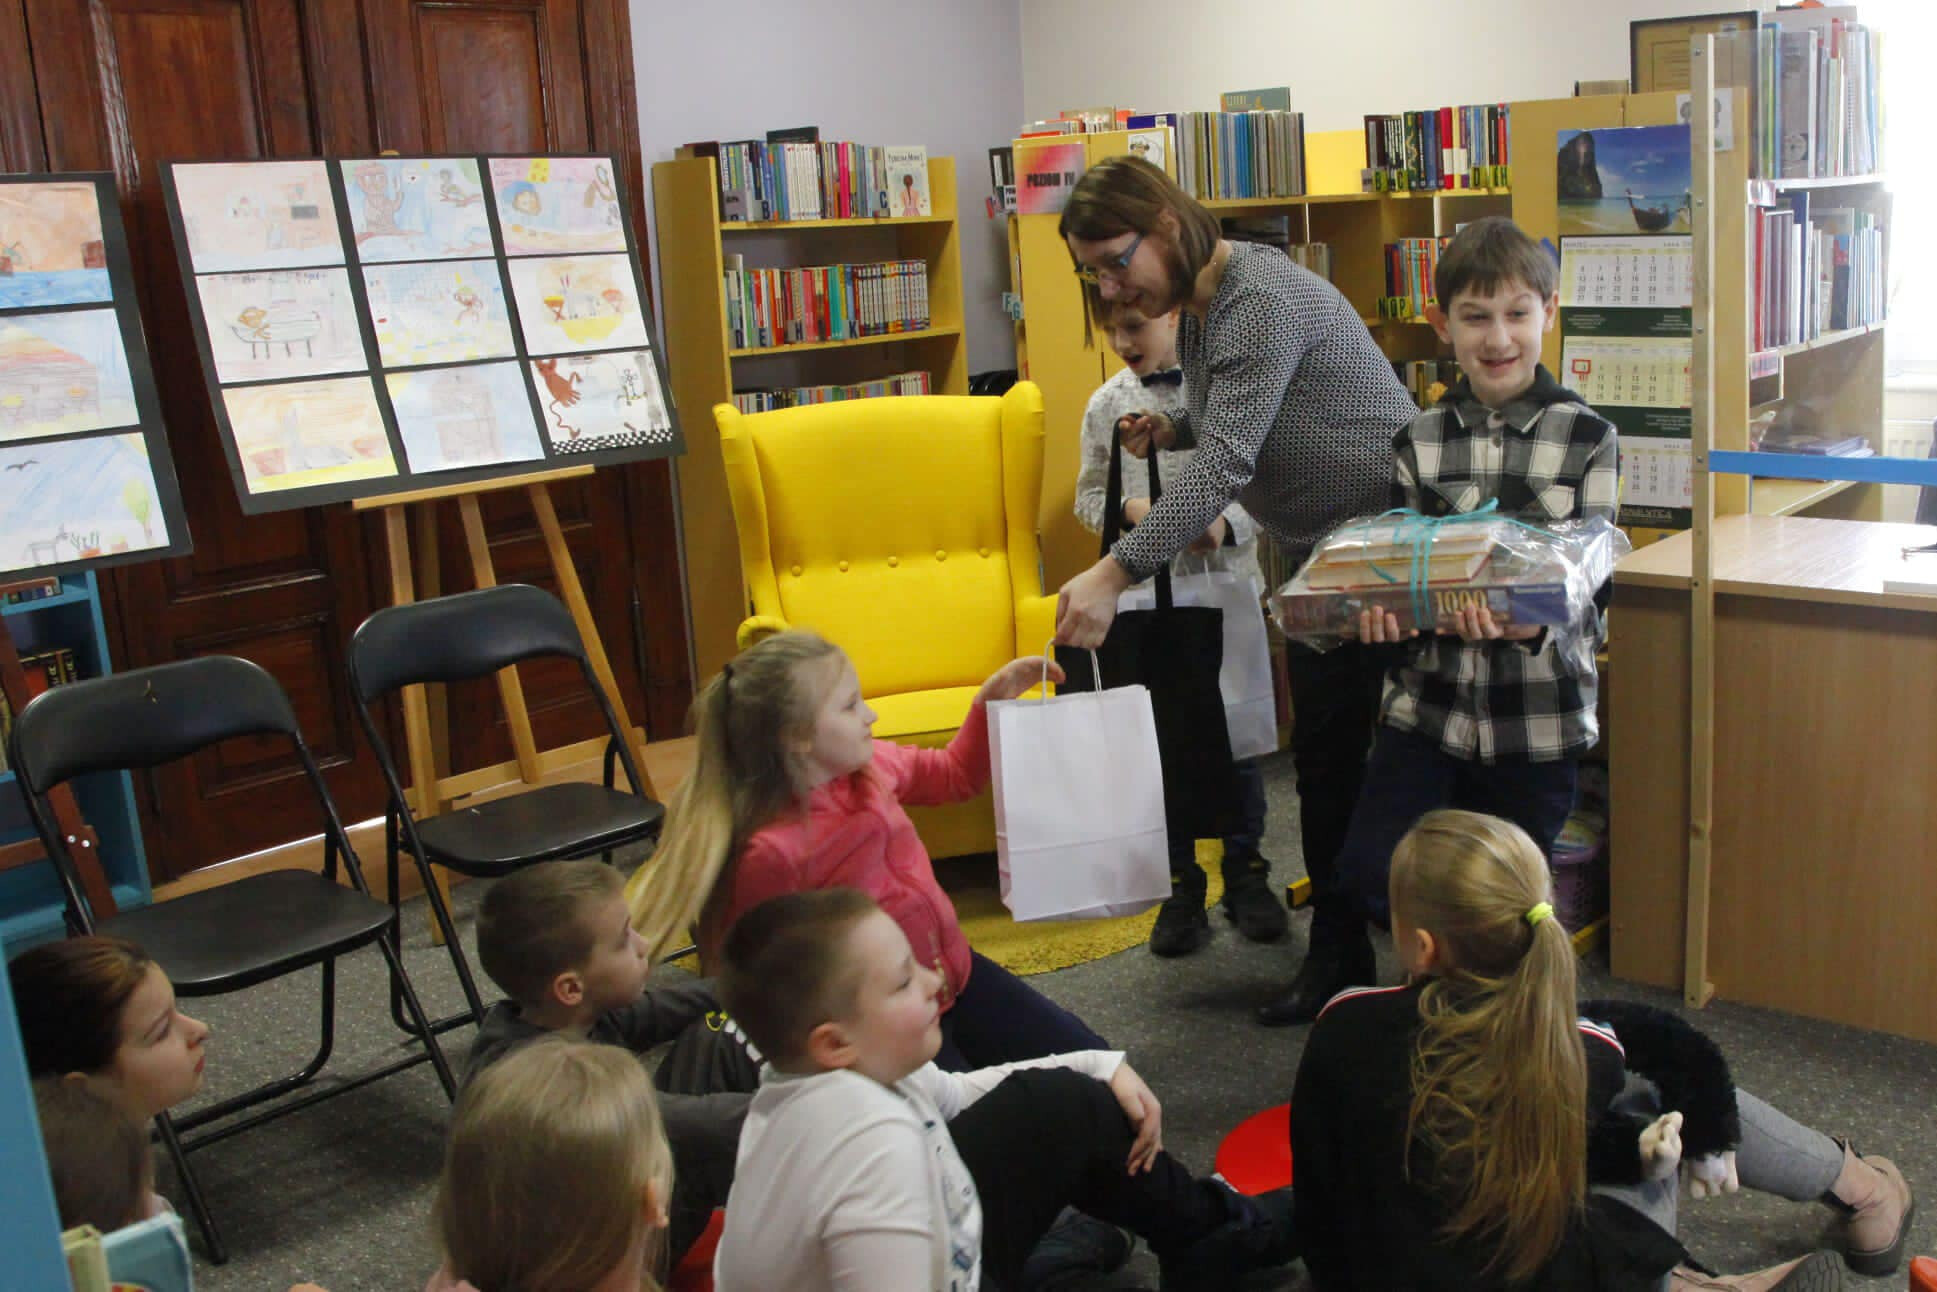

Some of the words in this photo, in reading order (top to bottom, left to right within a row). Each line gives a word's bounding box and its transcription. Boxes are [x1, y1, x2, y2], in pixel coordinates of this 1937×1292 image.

[761, 200, 770, 220] B
[880, 191, 888, 209] C
[849, 319, 858, 339] K
[1435, 590, 1487, 616] 1000
